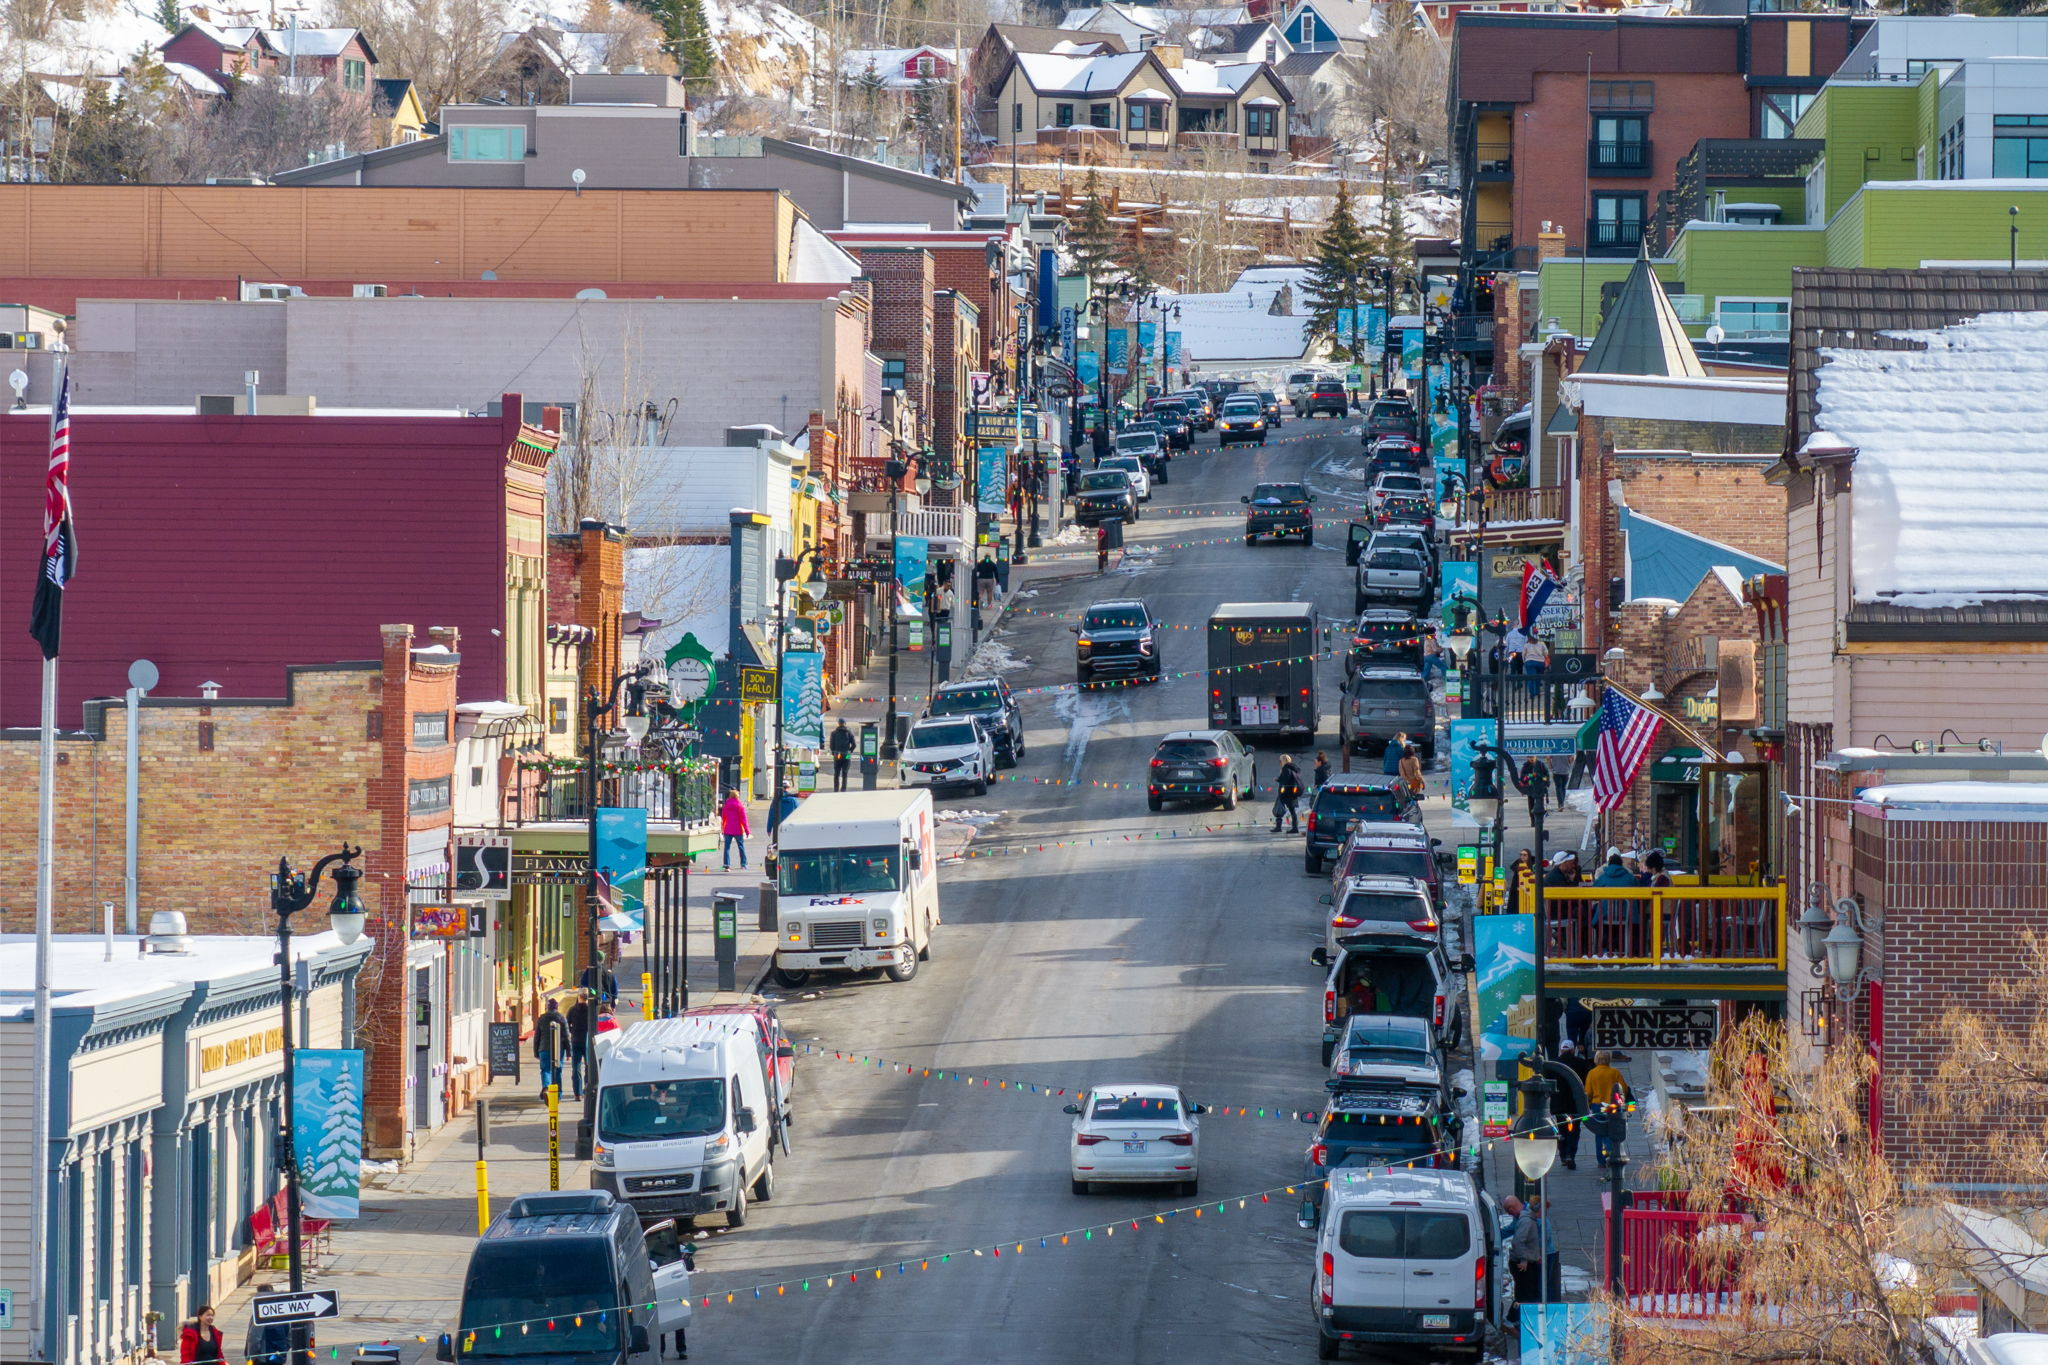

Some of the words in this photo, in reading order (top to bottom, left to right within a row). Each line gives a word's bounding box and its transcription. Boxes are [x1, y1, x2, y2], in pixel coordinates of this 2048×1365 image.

[1063, 336, 1071, 363] MAIN
[1018, 317, 1026, 399] EGYTIAN
[1002, 427, 1031, 436] JENNGS
[847, 570, 872, 580] ALPINE
[1237, 632, 1254, 641] ups
[746, 684, 772, 694] GALLO
[1506, 739, 1557, 749] ODBURY
[457, 837, 508, 846] SHABU
[809, 896, 865, 907] FedEx
[1596, 1009, 1697, 1029] ANNEX
[1596, 1029, 1715, 1048] BURGER
[641, 1179, 677, 1187] RAM
[261, 1303, 284, 1316] ONE
[288, 1300, 311, 1313] WAY
